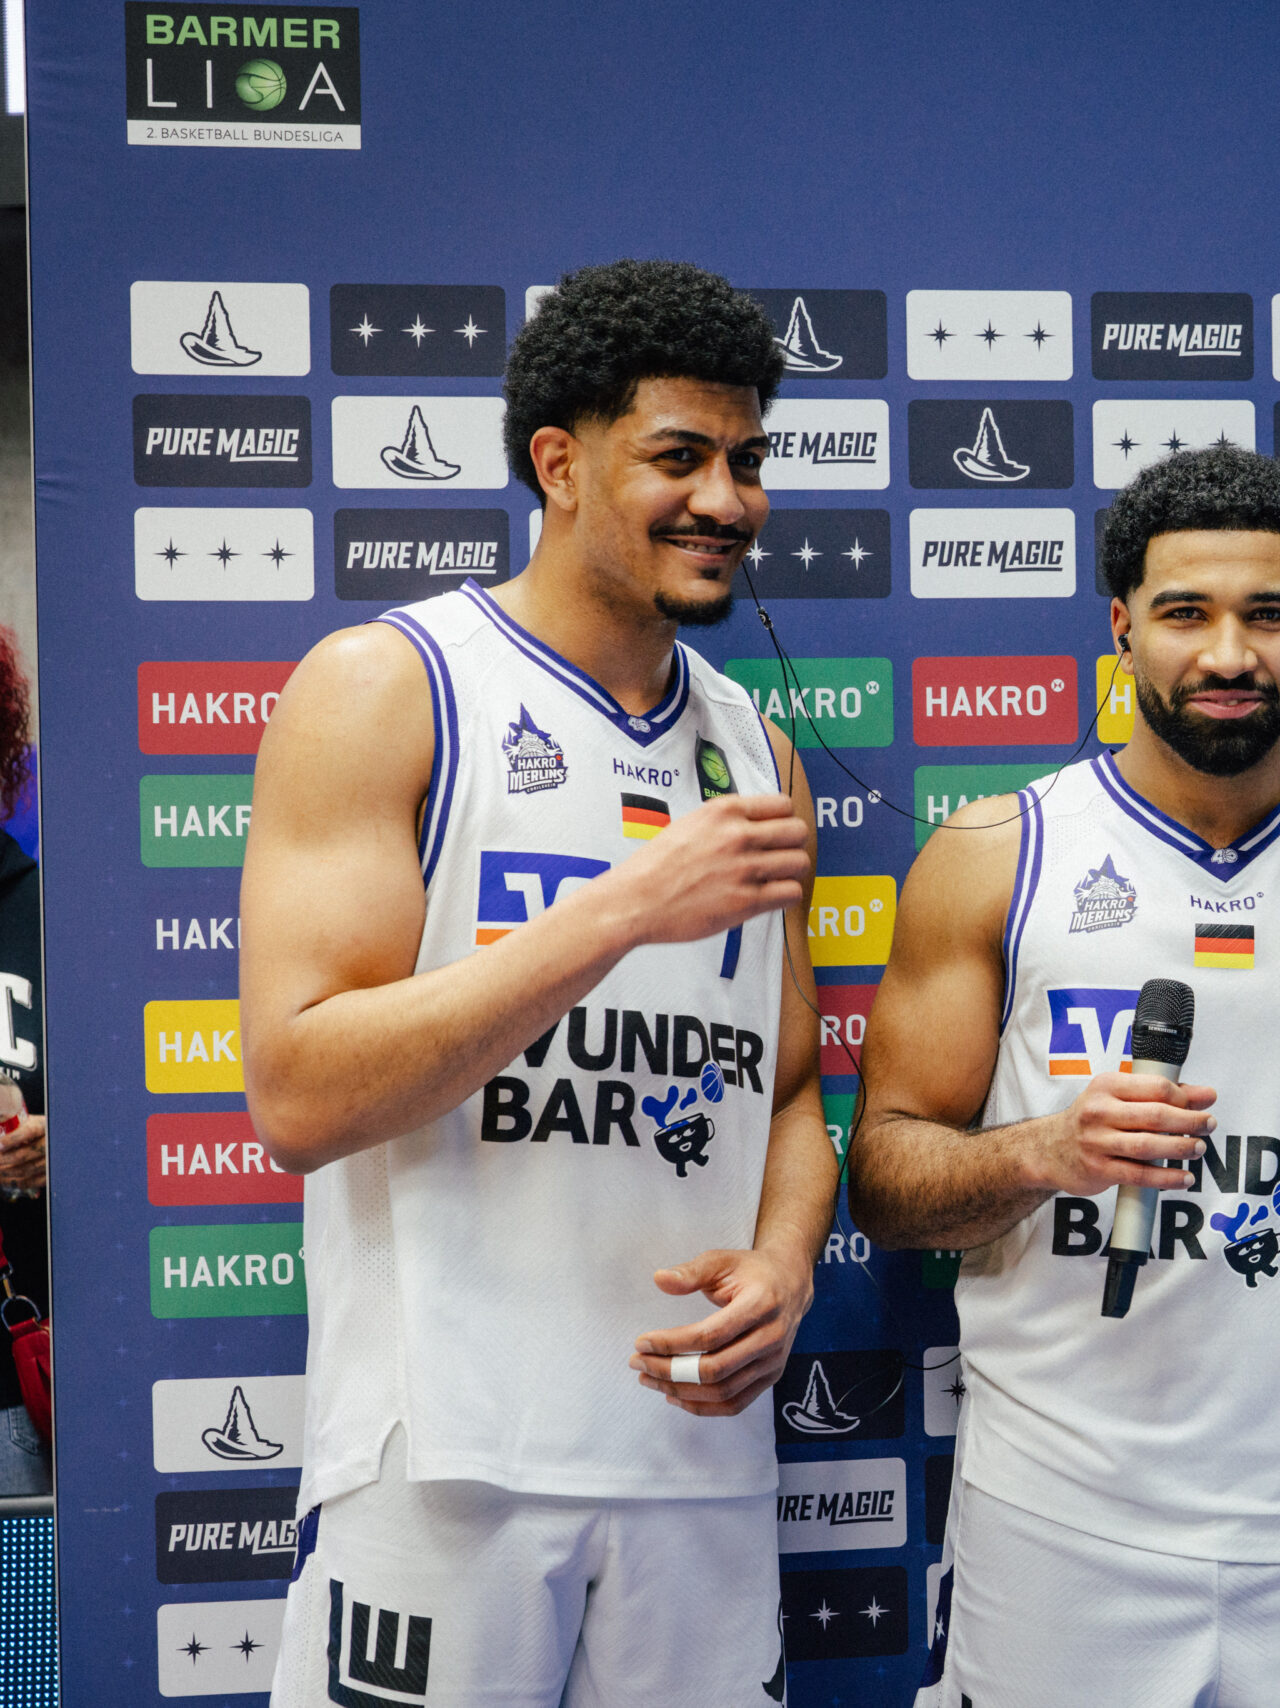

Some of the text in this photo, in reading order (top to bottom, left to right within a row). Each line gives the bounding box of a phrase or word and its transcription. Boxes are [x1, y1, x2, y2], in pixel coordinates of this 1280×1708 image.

[146, 14, 341, 49] BARMER
[146, 127, 344, 143] 2. BASKETBALL BUNDESLIGA
[1103, 323, 1244, 357] PURE MAGIC
[145, 427, 300, 463] PURE MAGIC
[766, 432, 878, 464] RE MAGIC
[346, 541, 498, 576] PURE MAGIC
[922, 540, 1064, 573] PURE MAGIC
[752, 687, 862, 719] AKRO
[925, 684, 1047, 718] HAKRO
[509, 768, 565, 791] MERLINS
[517, 757, 557, 770] HAKRO
[613, 757, 672, 788] HAKRO
[154, 804, 252, 838] HAKR
[1071, 908, 1133, 931] MERLINS
[1084, 898, 1127, 911] HAKRO
[1190, 893, 1256, 914] HAKRO
[156, 917, 241, 950] HAK
[158, 1030, 238, 1064] HAK
[481, 1075, 641, 1147] BAR
[163, 1252, 294, 1289] HAKRO
[817, 1489, 895, 1526] MAGIC
[167, 1519, 298, 1556] PURE MAG
